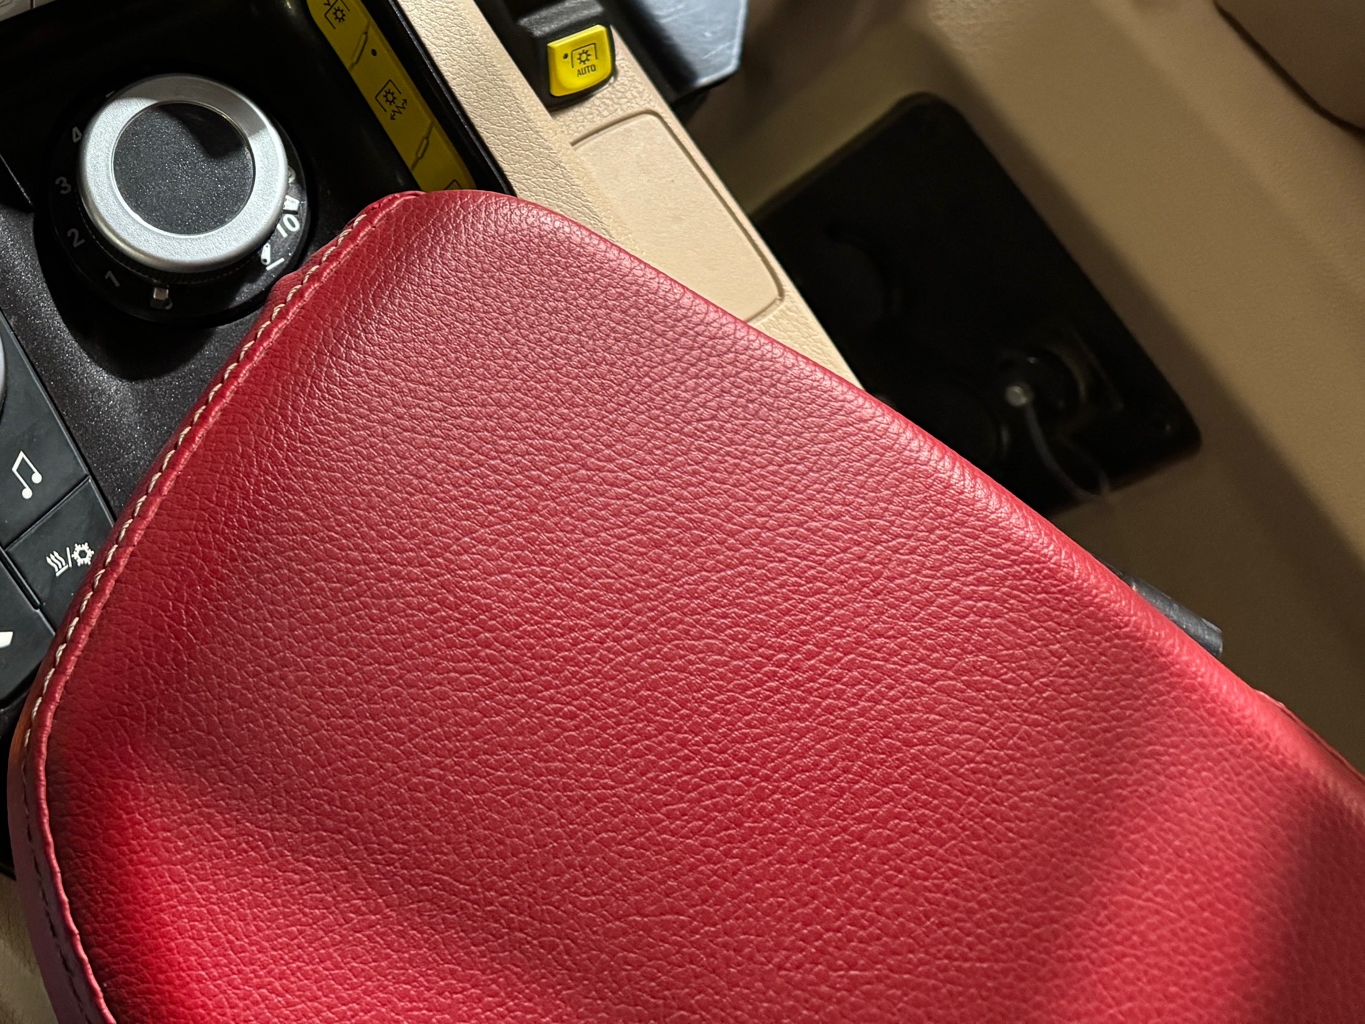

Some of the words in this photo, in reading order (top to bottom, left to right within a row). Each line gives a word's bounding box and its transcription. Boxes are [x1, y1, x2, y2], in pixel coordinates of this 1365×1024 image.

[577, 64, 597, 78] AUTO
[71, 125, 83, 143] 4
[54, 175, 72, 195] 3
[276, 214, 300, 237] 10
[67, 228, 85, 248] 2
[104, 270, 121, 288] 1
